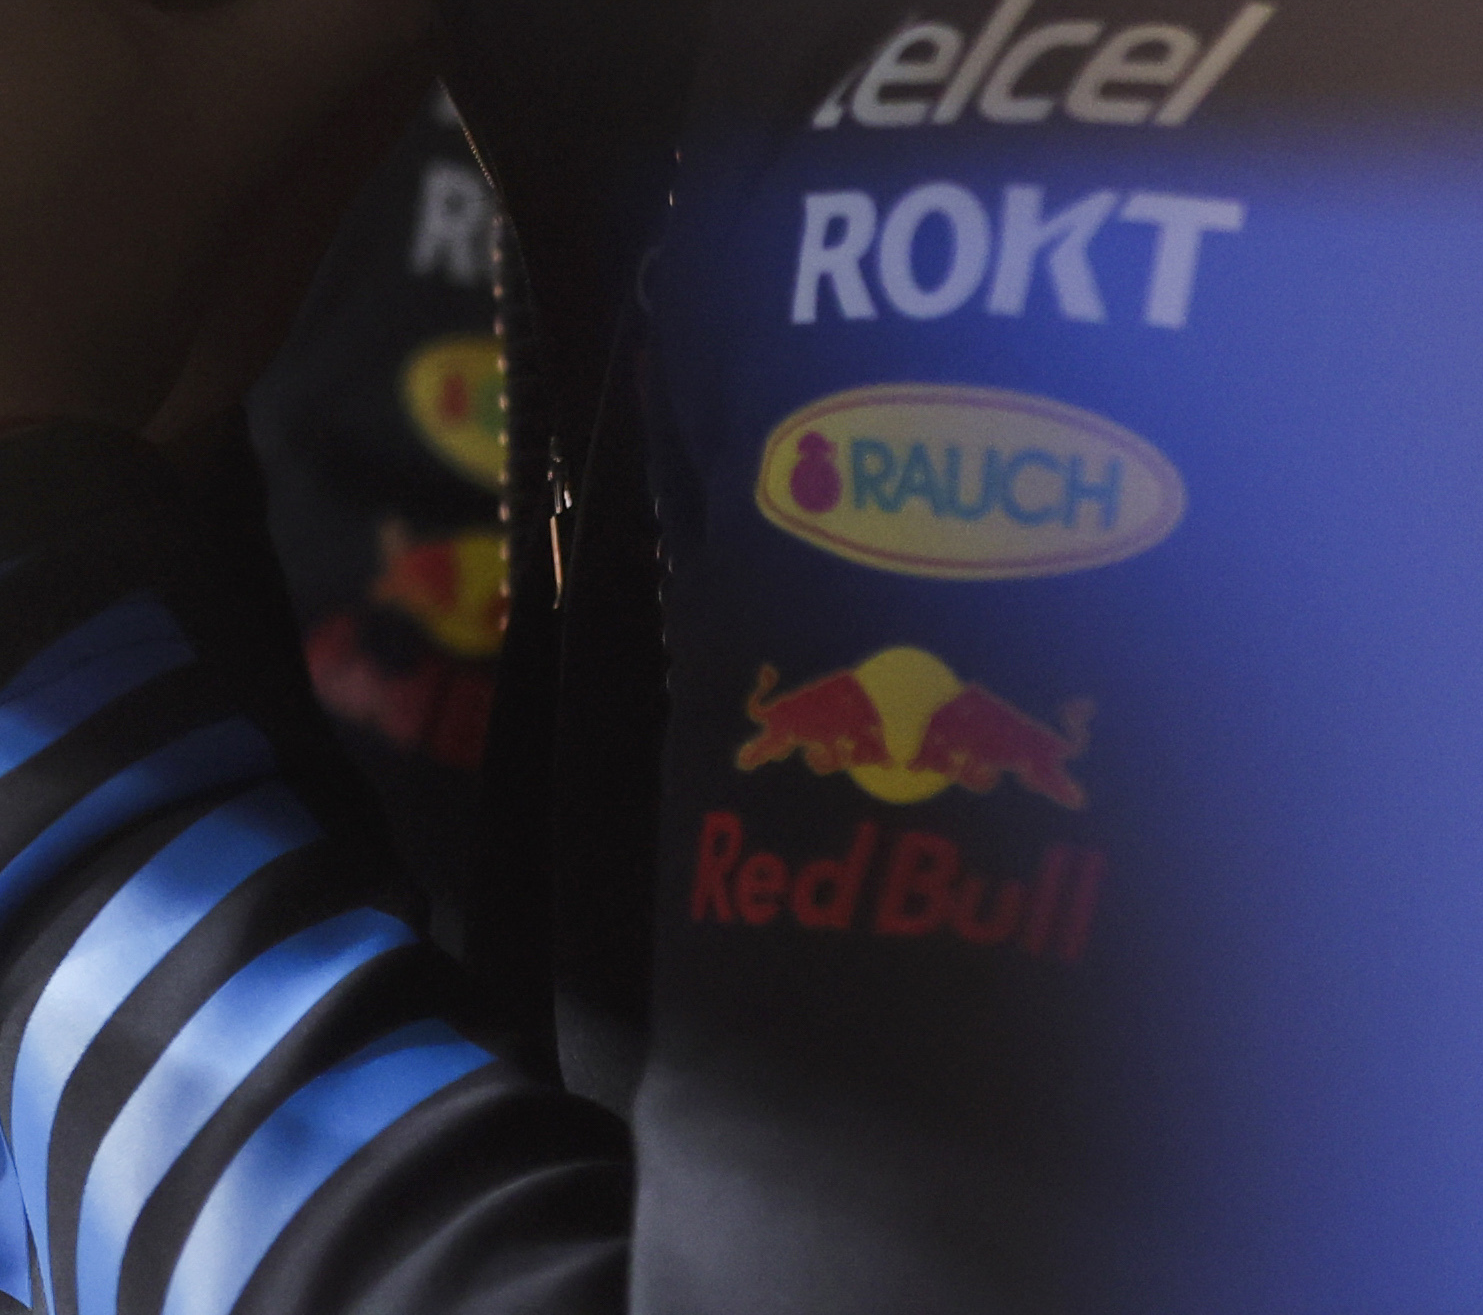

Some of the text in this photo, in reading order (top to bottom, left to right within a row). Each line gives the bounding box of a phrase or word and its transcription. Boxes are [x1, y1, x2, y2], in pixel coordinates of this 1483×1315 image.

[790, 180, 1248, 329] ROKT
[851, 438, 1124, 530] RAUCH
[690, 811, 1107, 961] Red Bull
